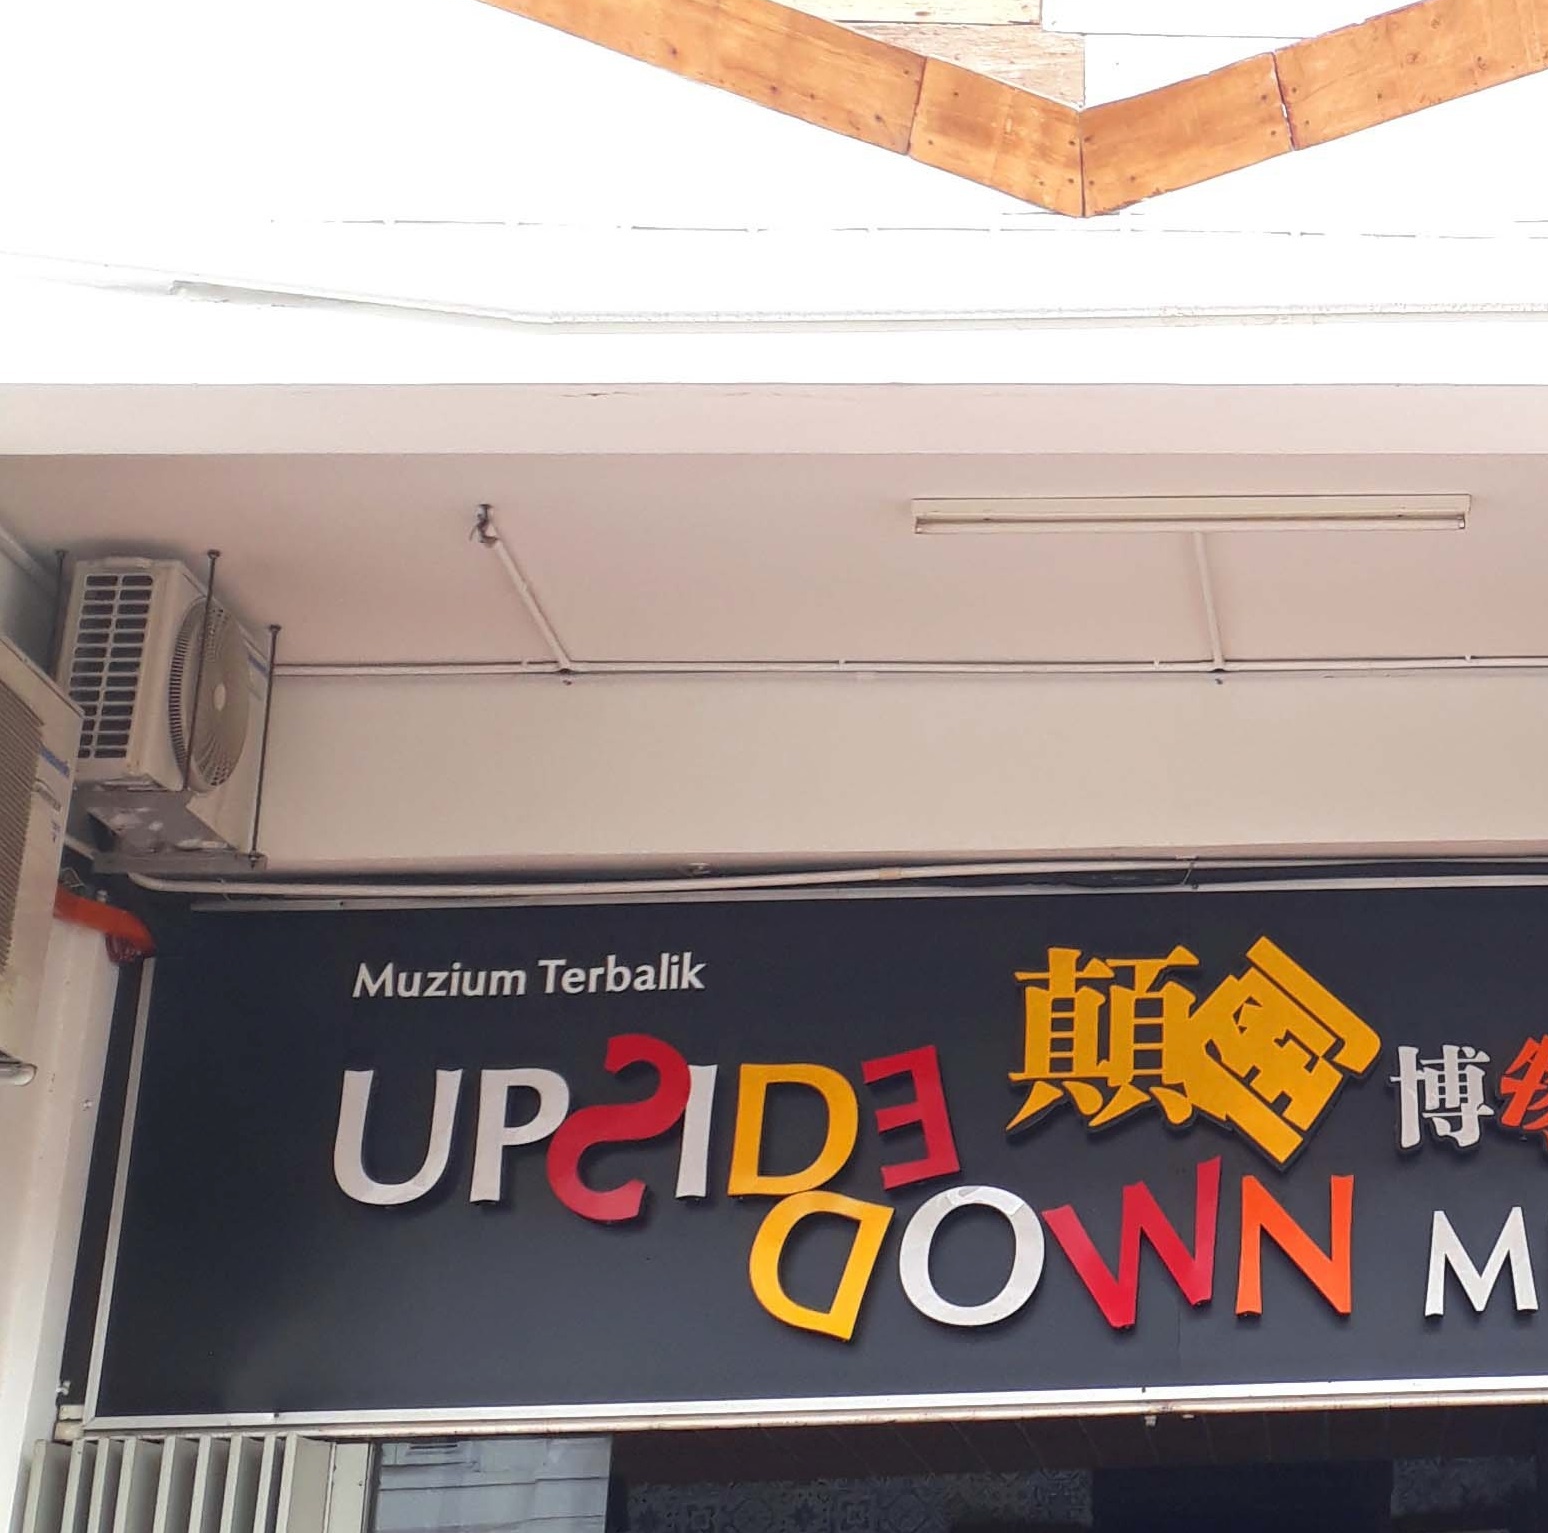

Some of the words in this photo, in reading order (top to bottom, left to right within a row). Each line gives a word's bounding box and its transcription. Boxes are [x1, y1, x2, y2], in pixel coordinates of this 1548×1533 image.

[352, 960, 527, 1000] Muzium
[537, 952, 706, 995] Terbalik
[332, 1032, 962, 1223] UPSIDE
[747, 1156, 1356, 1342] DOWN
